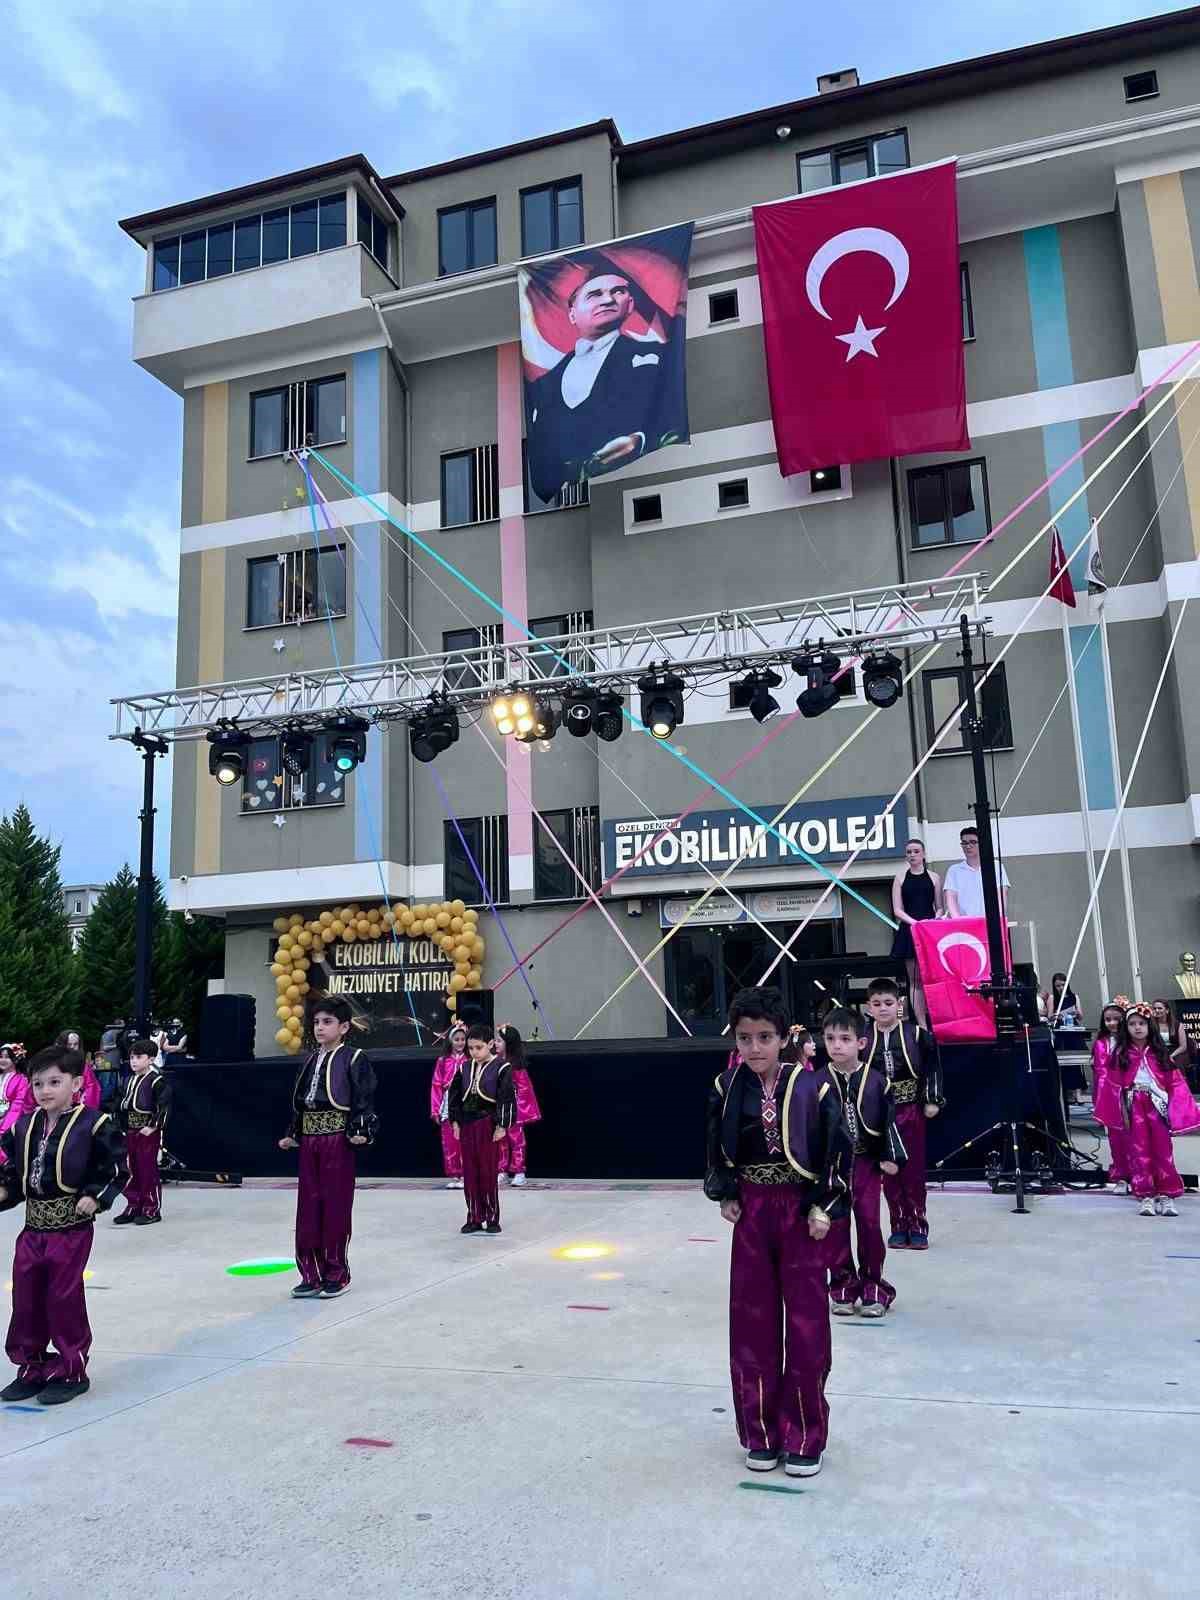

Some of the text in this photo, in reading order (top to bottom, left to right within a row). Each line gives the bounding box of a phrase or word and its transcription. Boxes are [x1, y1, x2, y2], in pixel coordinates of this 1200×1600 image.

[615, 804, 896, 869] EKOBİLİM KOLEJİ
[618, 823, 641, 832] ÖZEL
[335, 940, 455, 966] EKOBİLİM KOLE
[328, 971, 400, 993] MEZUNİYET
